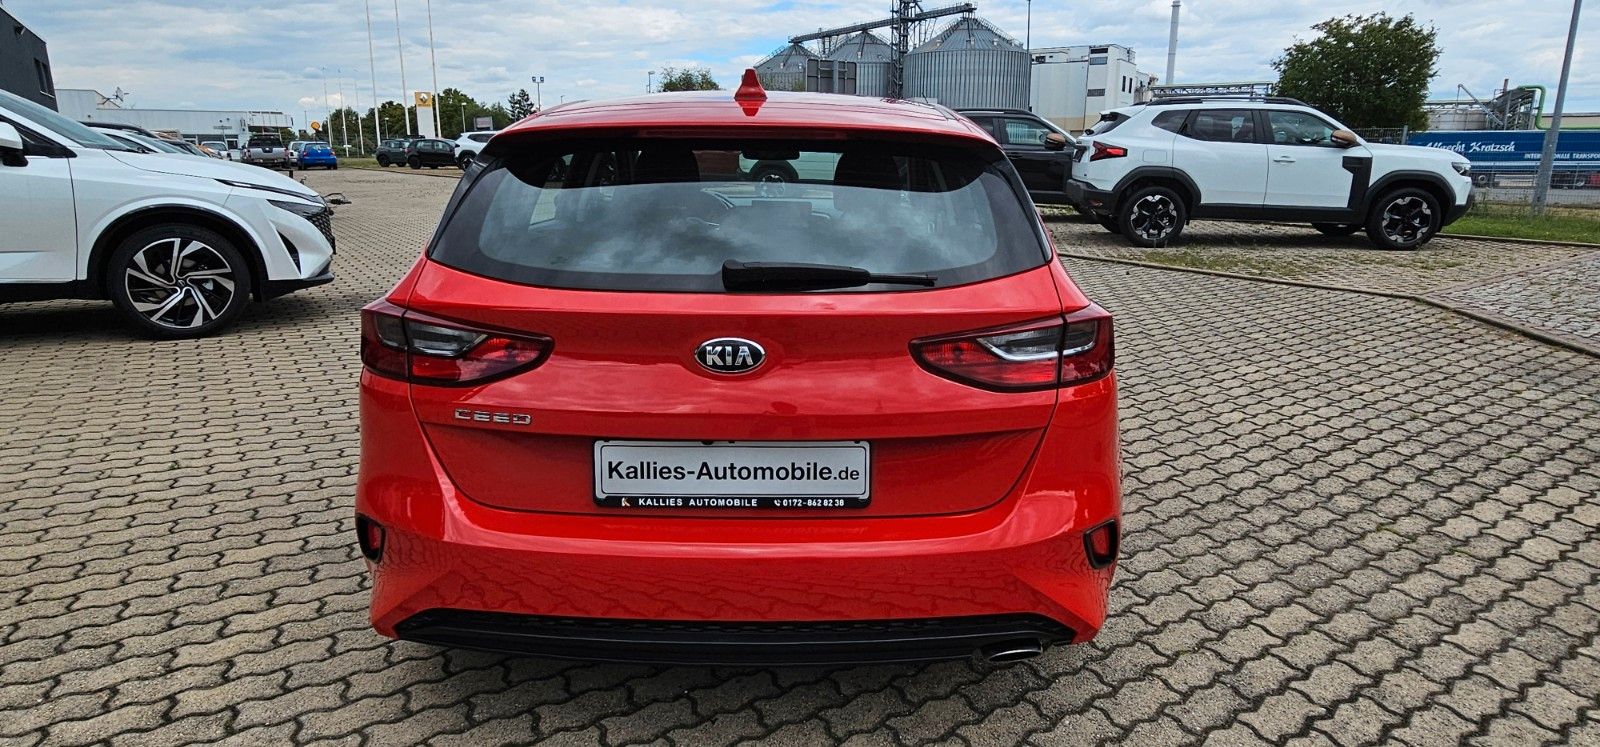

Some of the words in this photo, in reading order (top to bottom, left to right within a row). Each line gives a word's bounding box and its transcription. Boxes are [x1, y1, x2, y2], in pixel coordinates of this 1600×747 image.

[705, 346, 754, 366] KIA
[454, 408, 531, 425] CEED
[608, 460, 860, 481] Kallies-Automobile.de
[638, 498, 683, 506] KALLIES
[689, 498, 758, 507] AUTOMOBILE
[782, 498, 822, 507] 0172-862
